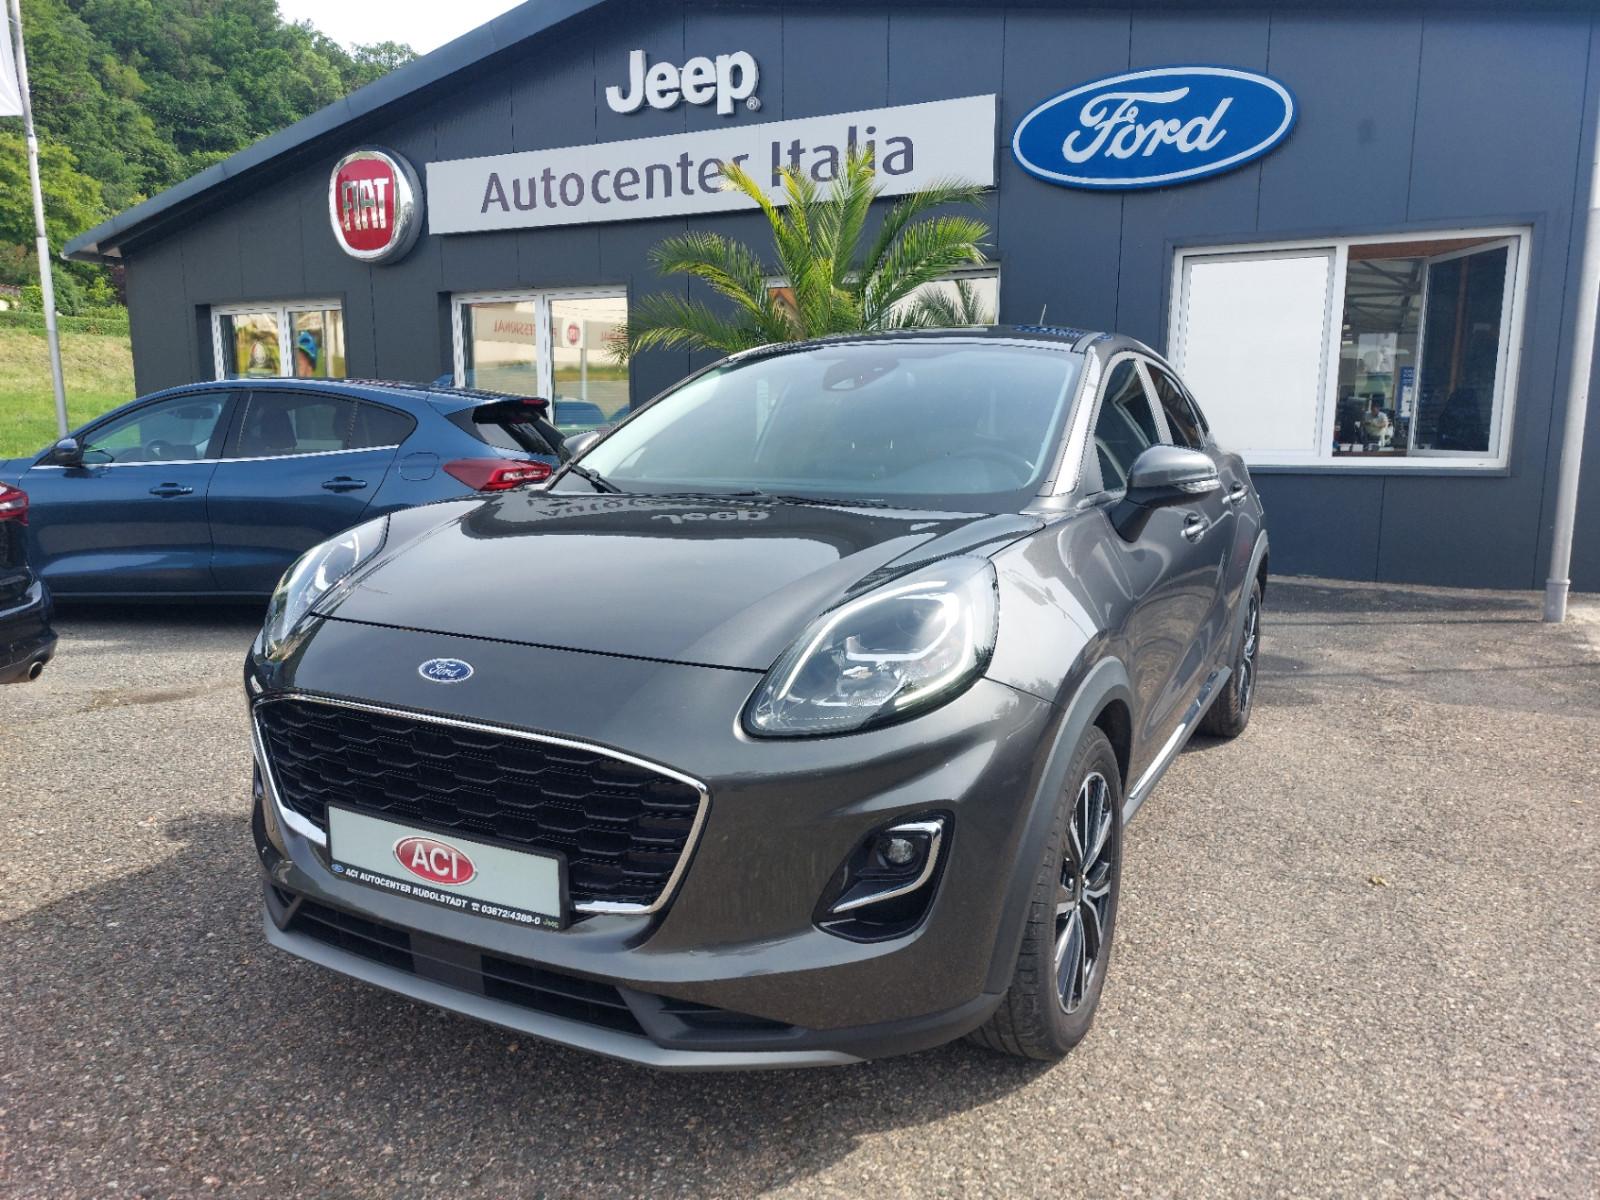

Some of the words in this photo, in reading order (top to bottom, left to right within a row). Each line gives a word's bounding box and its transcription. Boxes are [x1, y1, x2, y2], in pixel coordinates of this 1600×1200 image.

[1061, 86, 1235, 164] Ford
[480, 152, 750, 214] Autocenter
[771, 125, 914, 188] Italia
[341, 177, 390, 232] FIAT
[428, 662, 462, 677] Ford
[411, 843, 458, 880] ACI
[345, 868, 359, 878] ACI
[359, 872, 411, 894] AUTOCENTER
[412, 887, 468, 909] RUDOLSTADT
